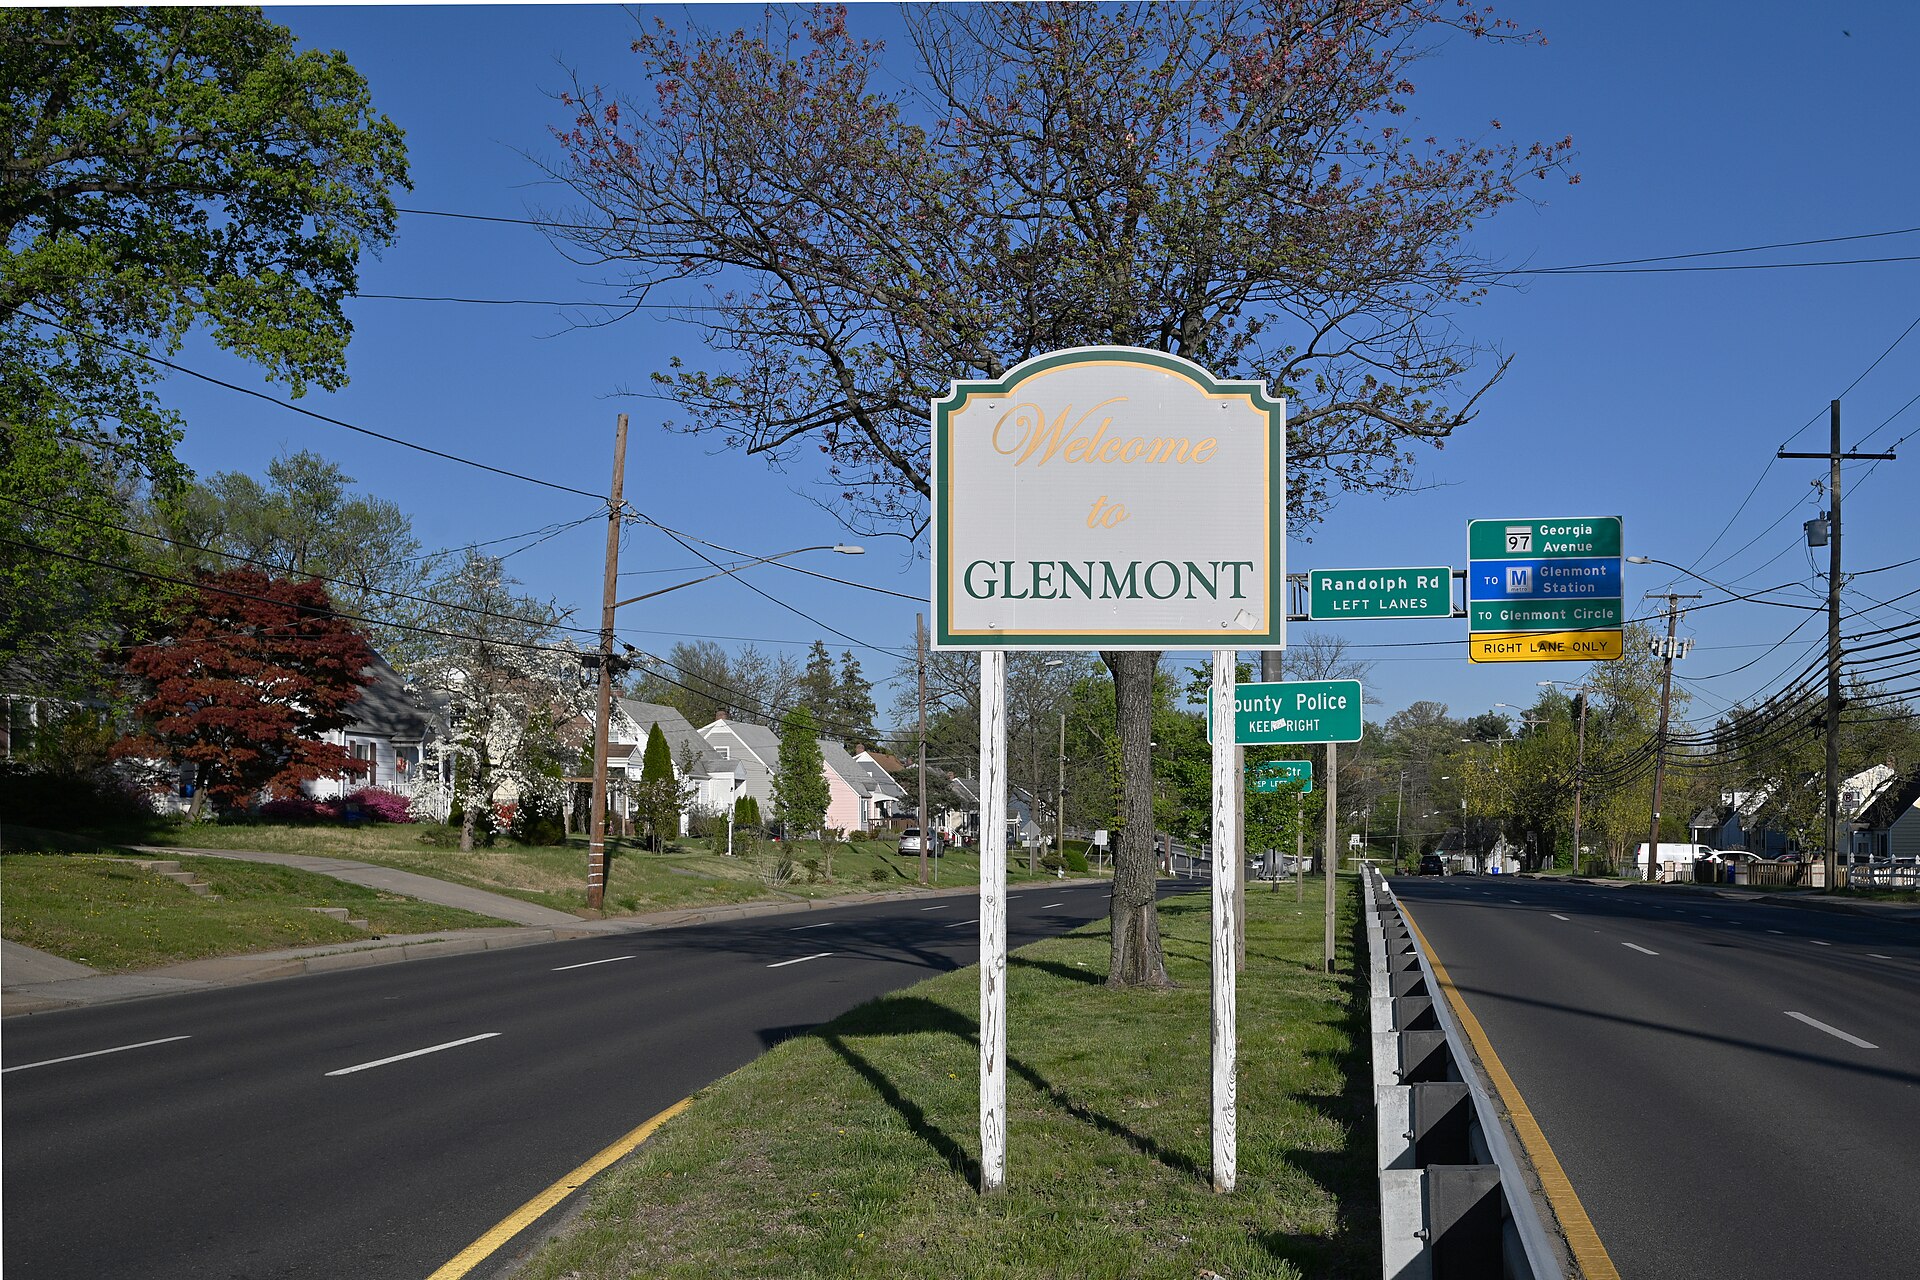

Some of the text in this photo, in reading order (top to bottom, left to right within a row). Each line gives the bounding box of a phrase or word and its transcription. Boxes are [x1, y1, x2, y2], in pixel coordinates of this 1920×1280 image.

[992, 397, 1218, 467] Welcome
[1087, 495, 1130, 529] to
[1540, 524, 1592, 537] Georgia
[1508, 536, 1529, 550] 97
[1543, 542, 1592, 552] Avenue
[1540, 565, 1607, 577] Glenmont
[963, 560, 1254, 600] GLENMONT
[1321, 575, 1439, 592] Randolph Rd
[1484, 576, 1499, 585] TO
[1511, 570, 1527, 586] M
[1543, 582, 1595, 593] Station
[1333, 598, 1428, 610] LEFT LANES
[1478, 608, 1614, 620] TO Glenmont Circle
[1484, 641, 1608, 653] RIGHT LANE ONLY
[1235, 693, 1347, 714] ounty Police
[1286, 719, 1320, 731] RIGHT
[1286, 767, 1301, 777] Ctr
